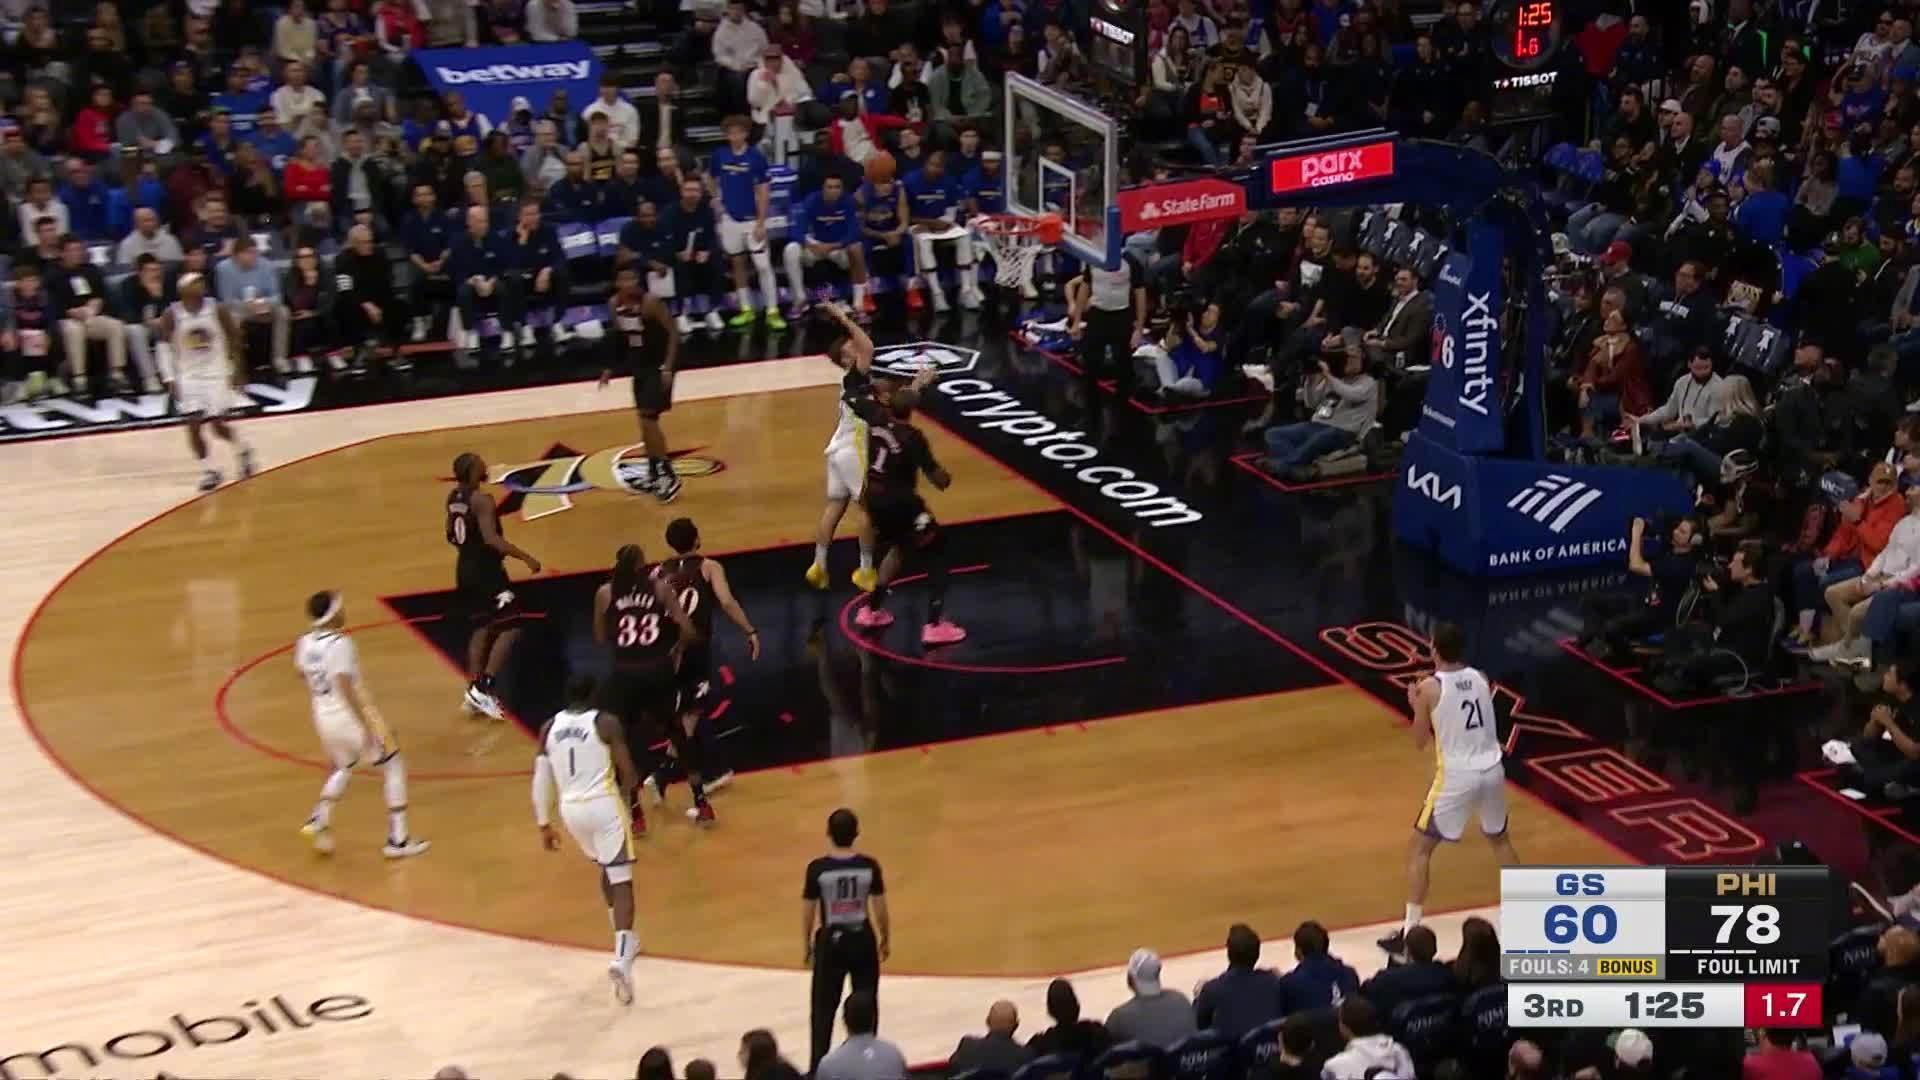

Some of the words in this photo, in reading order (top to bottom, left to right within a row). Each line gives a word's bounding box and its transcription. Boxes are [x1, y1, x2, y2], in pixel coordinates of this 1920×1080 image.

[1519, 2, 1552, 26] 1:25
[1517, 29, 1539, 57] 1.6
[436, 59, 591, 84] betway
[1511, 71, 1558, 88] TISSOT
[1301, 149, 1363, 183] parx
[1311, 172, 1355, 188] casino
[1458, 290, 1498, 415] xfinity
[937, 379, 1203, 527] crypto.com
[454, 515, 466, 545] 0
[1489, 549, 1531, 567] BANK
[1535, 546, 1555, 561] OF
[1557, 537, 1628, 559] AMERICA
[617, 613, 660, 647] 33
[1461, 698, 1484, 731] 21
[569, 747, 576, 777] 1
[0, 995, 374, 1080] mobile
